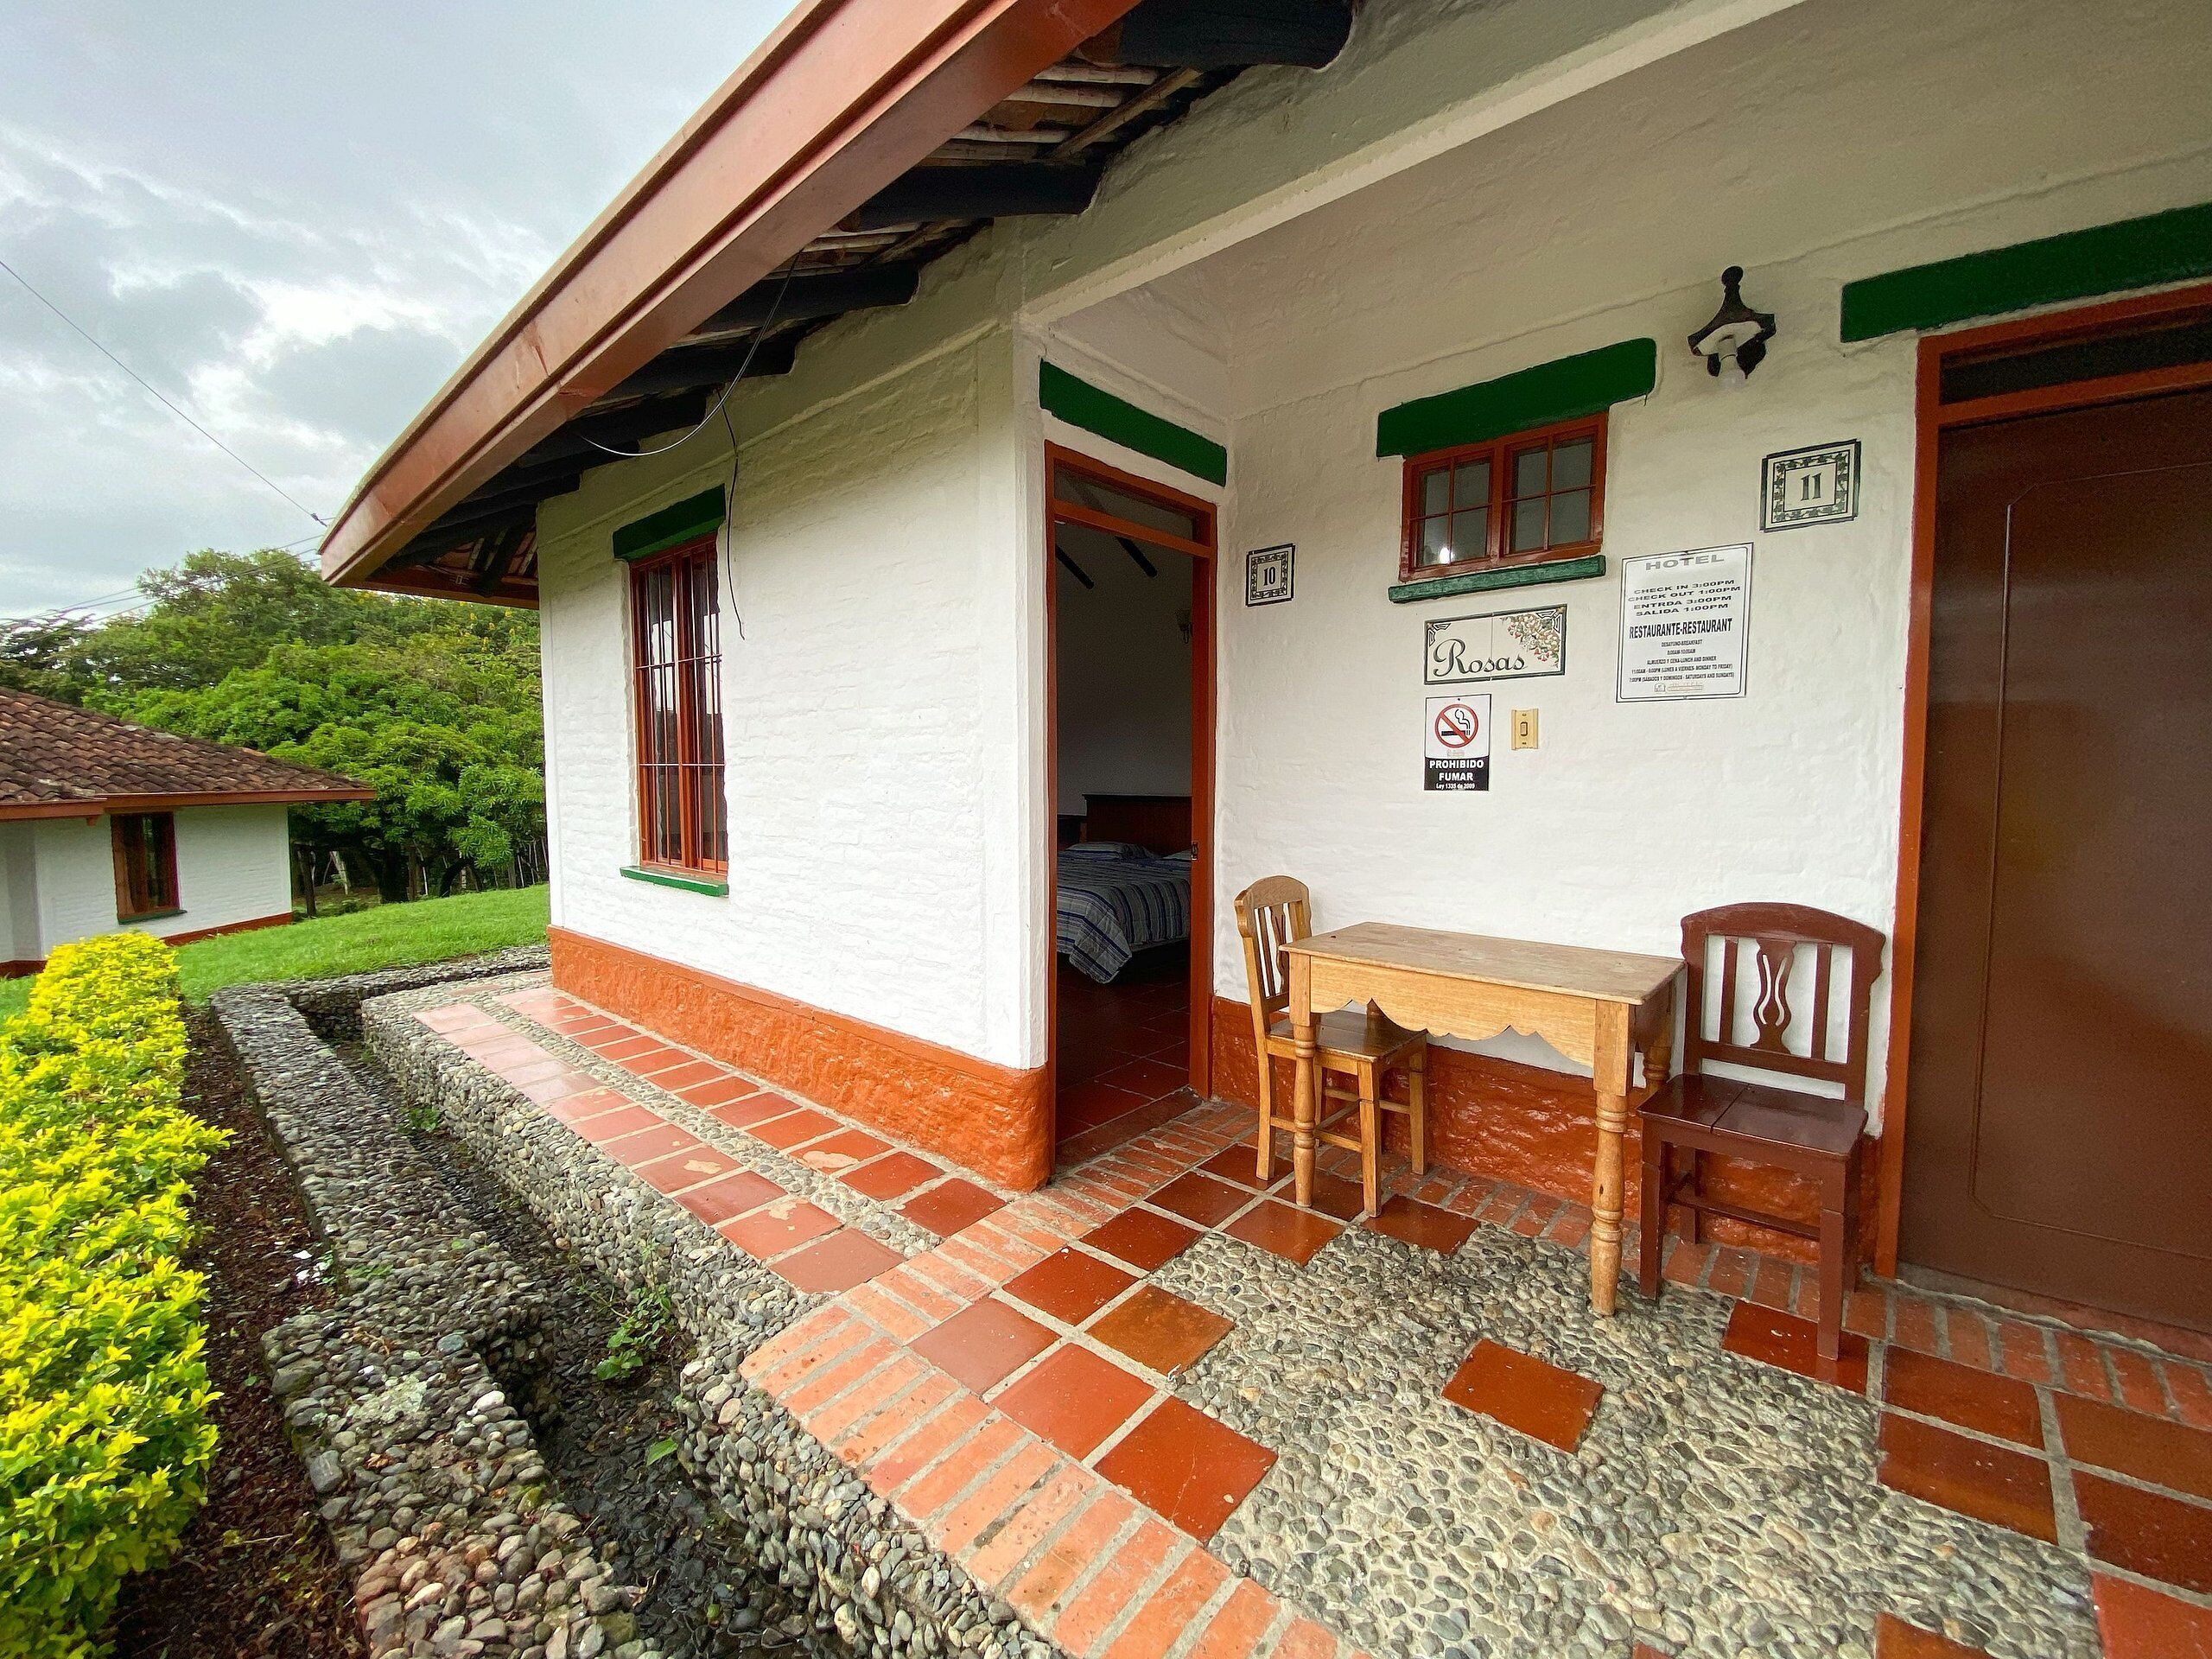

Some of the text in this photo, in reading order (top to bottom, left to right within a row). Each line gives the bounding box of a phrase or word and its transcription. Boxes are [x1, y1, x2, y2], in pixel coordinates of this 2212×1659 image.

[1800, 473, 1822, 501] 11
[1645, 554, 1725, 570] HOTEL
[1263, 566, 1276, 586] 10
[1628, 593, 1667, 602] CHECK
[1698, 586, 1741, 594] 1:00PM
[1634, 586, 1673, 594] CHECK
[1693, 580, 1735, 588] 3:00PM
[1633, 595, 1732, 610] ENTRDA 3:00PM
[1636, 603, 1729, 617] SALIDA 1:00PM
[1629, 617, 1732, 639] RESTAURANTE-RESTAURANT
[1433, 638, 1528, 677] Rosas
[1429, 760, 1484, 769] PROHIBIDO
[1439, 772, 1474, 781] FUMAR
